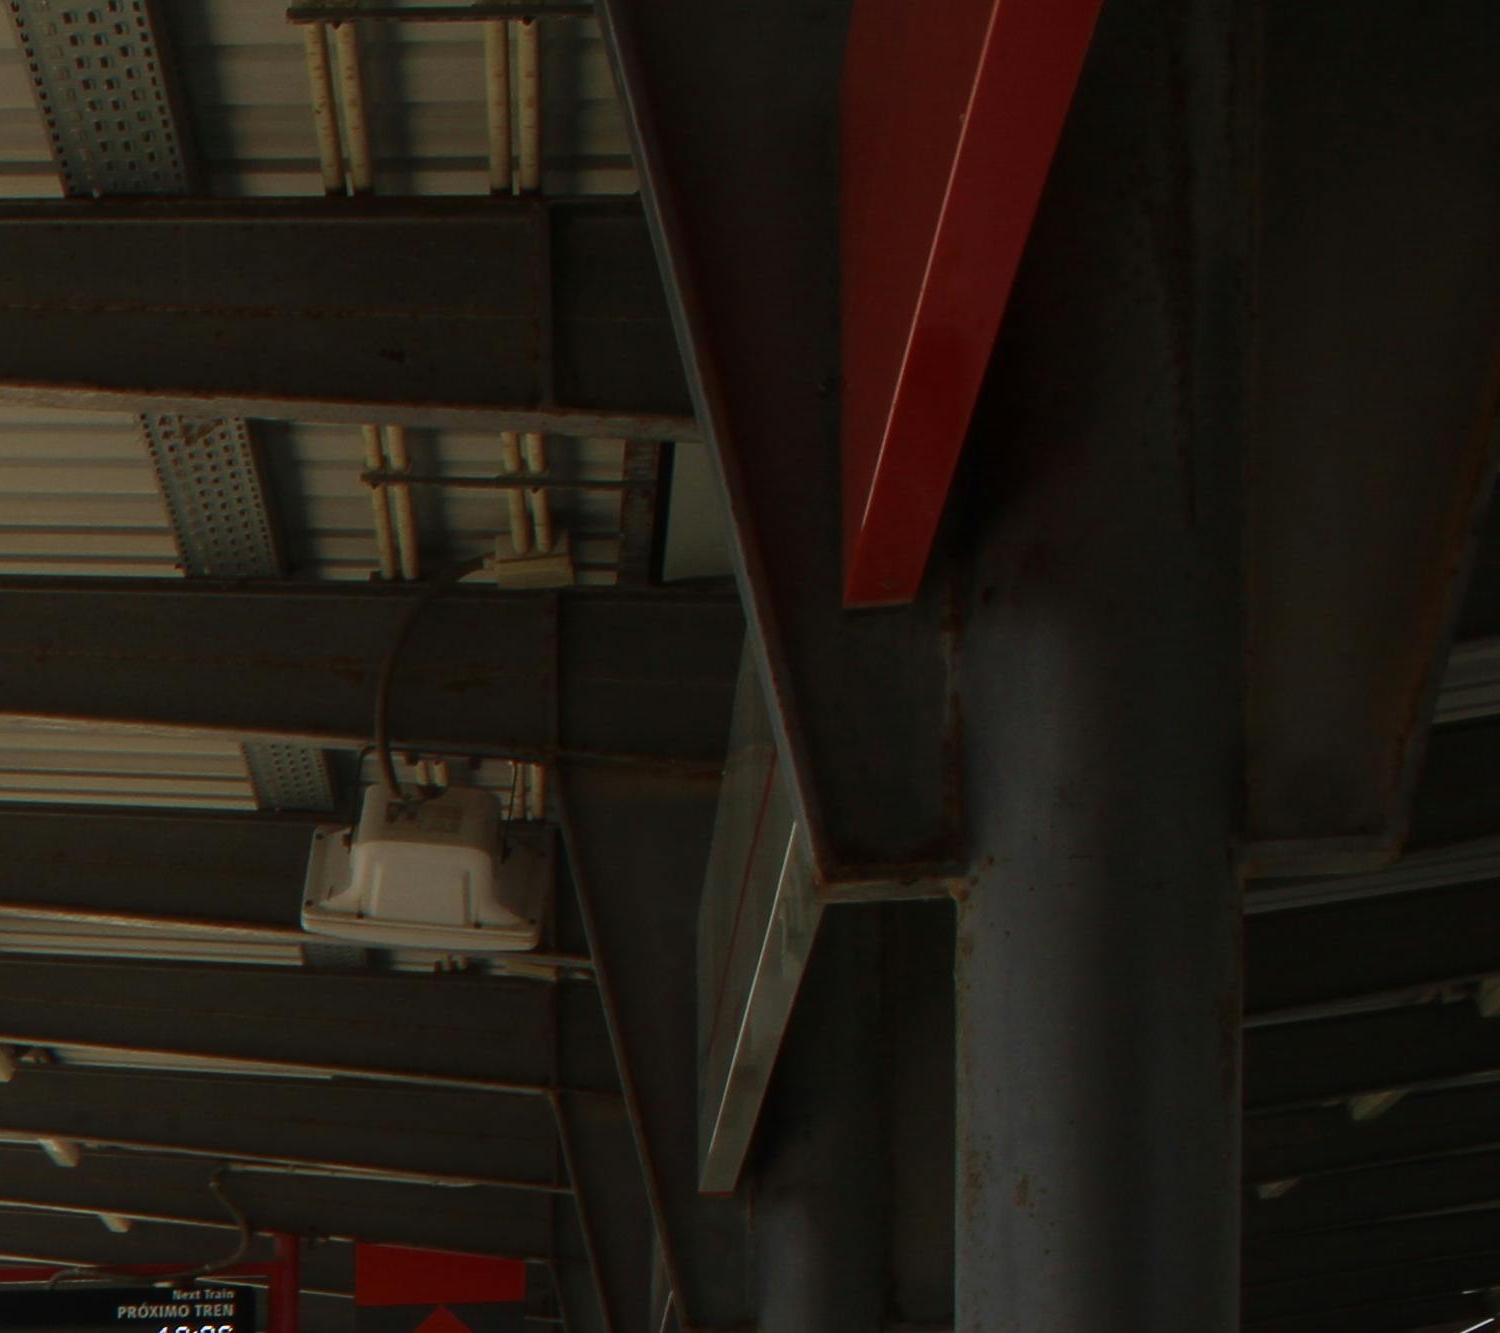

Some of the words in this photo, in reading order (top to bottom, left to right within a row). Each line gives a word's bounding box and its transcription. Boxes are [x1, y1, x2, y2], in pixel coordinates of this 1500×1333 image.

[172, 1289, 200, 1301] Next
[204, 1288, 235, 1300] Train
[117, 1303, 189, 1320] PRÓXIMO
[194, 1303, 235, 1318] TREN
